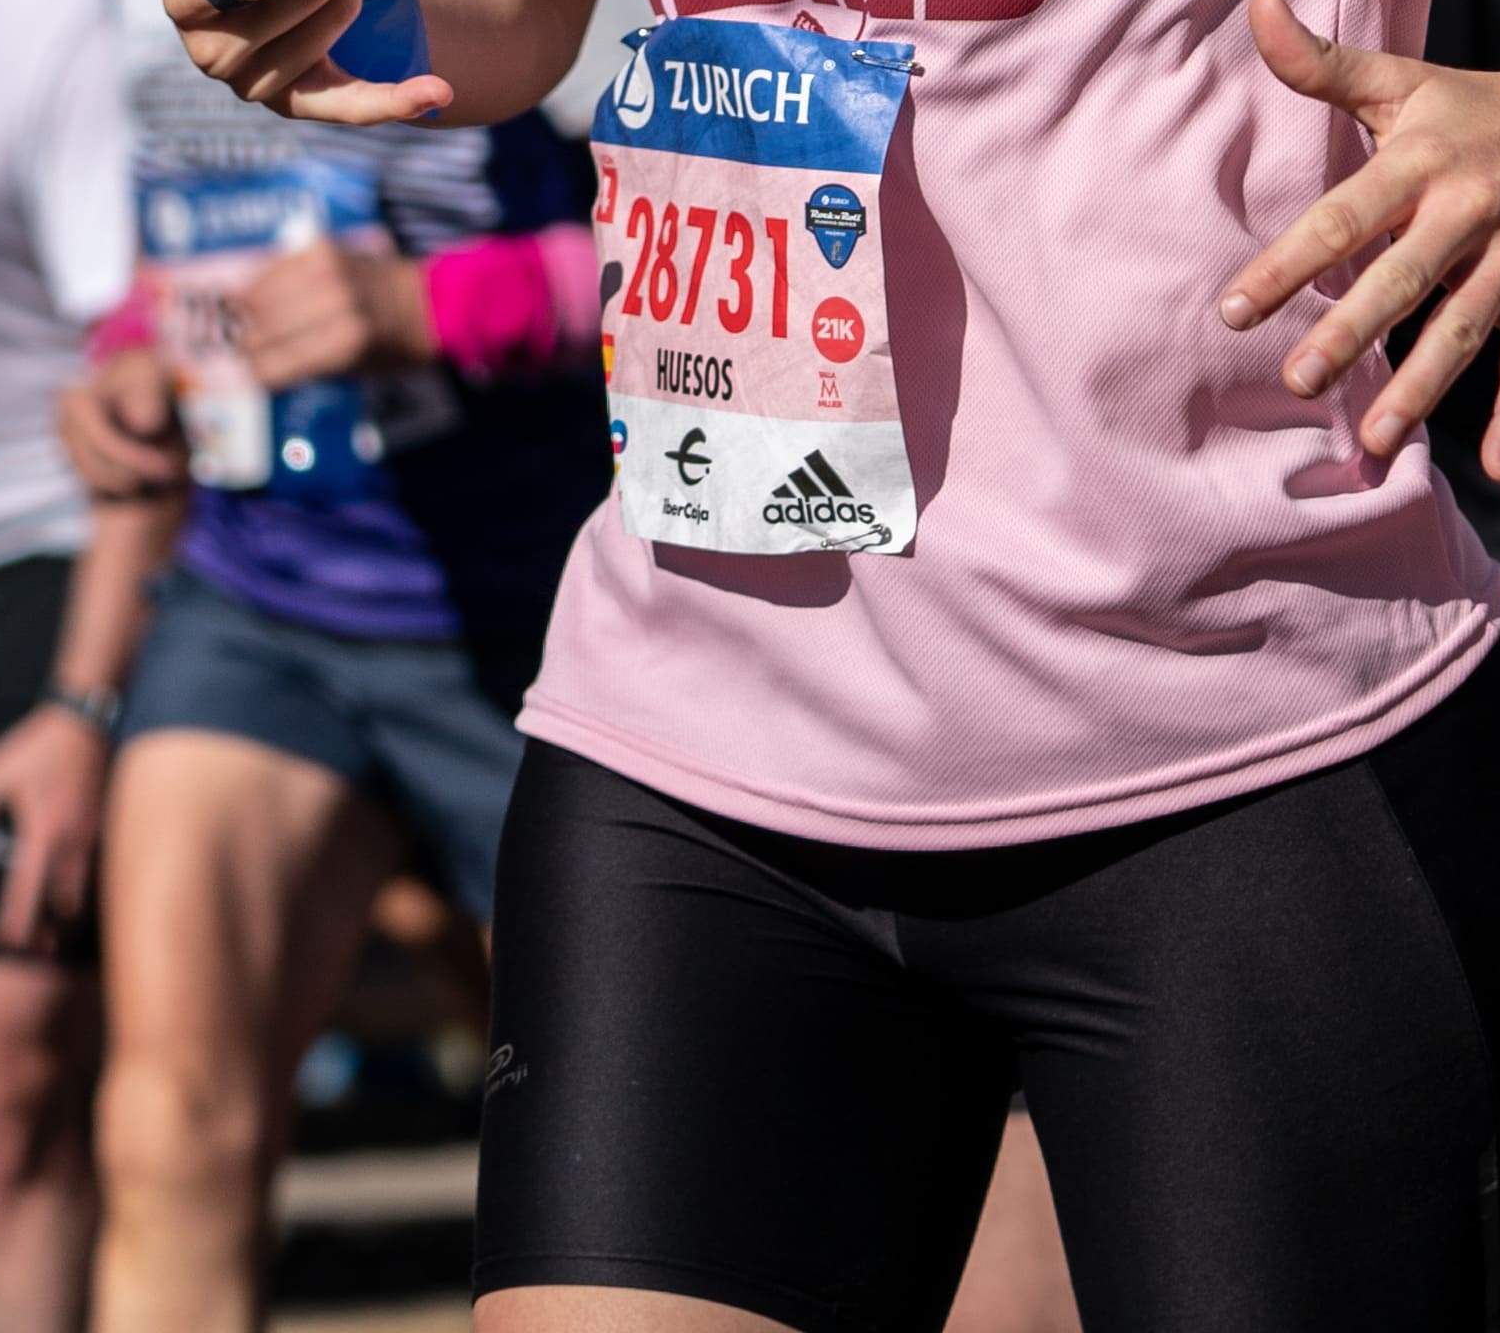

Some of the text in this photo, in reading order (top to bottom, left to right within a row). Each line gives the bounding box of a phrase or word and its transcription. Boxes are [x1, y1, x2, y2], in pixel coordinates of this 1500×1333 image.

[663, 60, 816, 125] ZURICH
[621, 196, 790, 340] 28731
[816, 317, 856, 341] 21K
[656, 347, 734, 401] HUESOS
[820, 379, 840, 399] M
[662, 498, 709, 522] iberCaja
[762, 496, 875, 526] adidas
